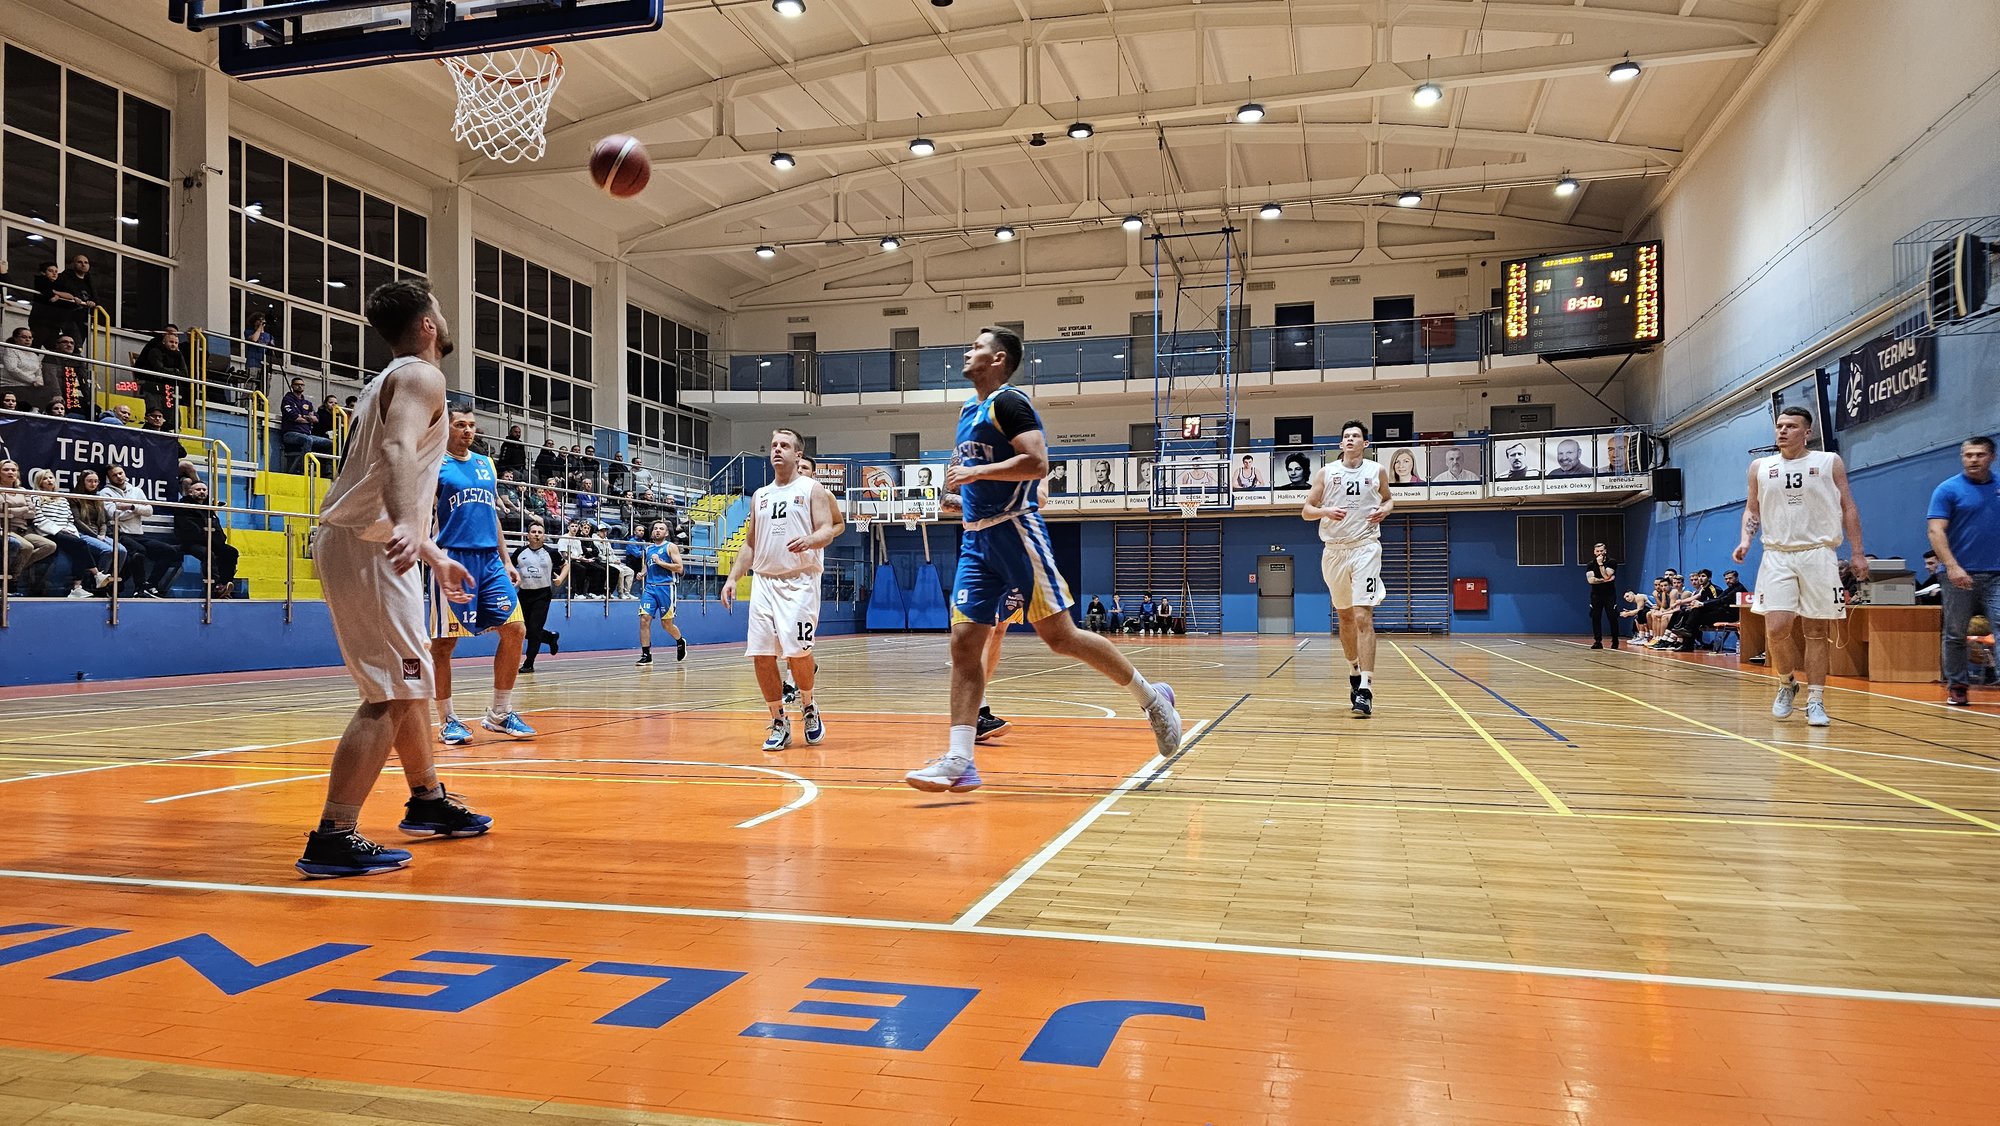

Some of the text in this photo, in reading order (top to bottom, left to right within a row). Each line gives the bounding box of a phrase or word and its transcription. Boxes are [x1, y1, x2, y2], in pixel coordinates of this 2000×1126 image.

[1574, 276, 1584, 287] 3
[1609, 268, 1628, 282] 45
[1534, 278, 1552, 293] 34
[1877, 338, 1916, 370] TERMY
[1868, 360, 1928, 404] CIEPLICKIE
[1184, 424, 1200, 436] 21
[56, 437, 144, 468] TERMY
[475, 469, 491, 481] 12
[1785, 473, 1803, 489] 13
[880, 490, 887, 501] C
[925, 488, 934, 500] B
[1346, 481, 1360, 495] 21
[771, 501, 787, 519] 12
[957, 589, 968, 604] 9
[1833, 587, 1845, 604] 13
[462, 611, 477, 623] 12
[797, 622, 812, 641] 12
[0, 925, 1204, 1066] JELENI
